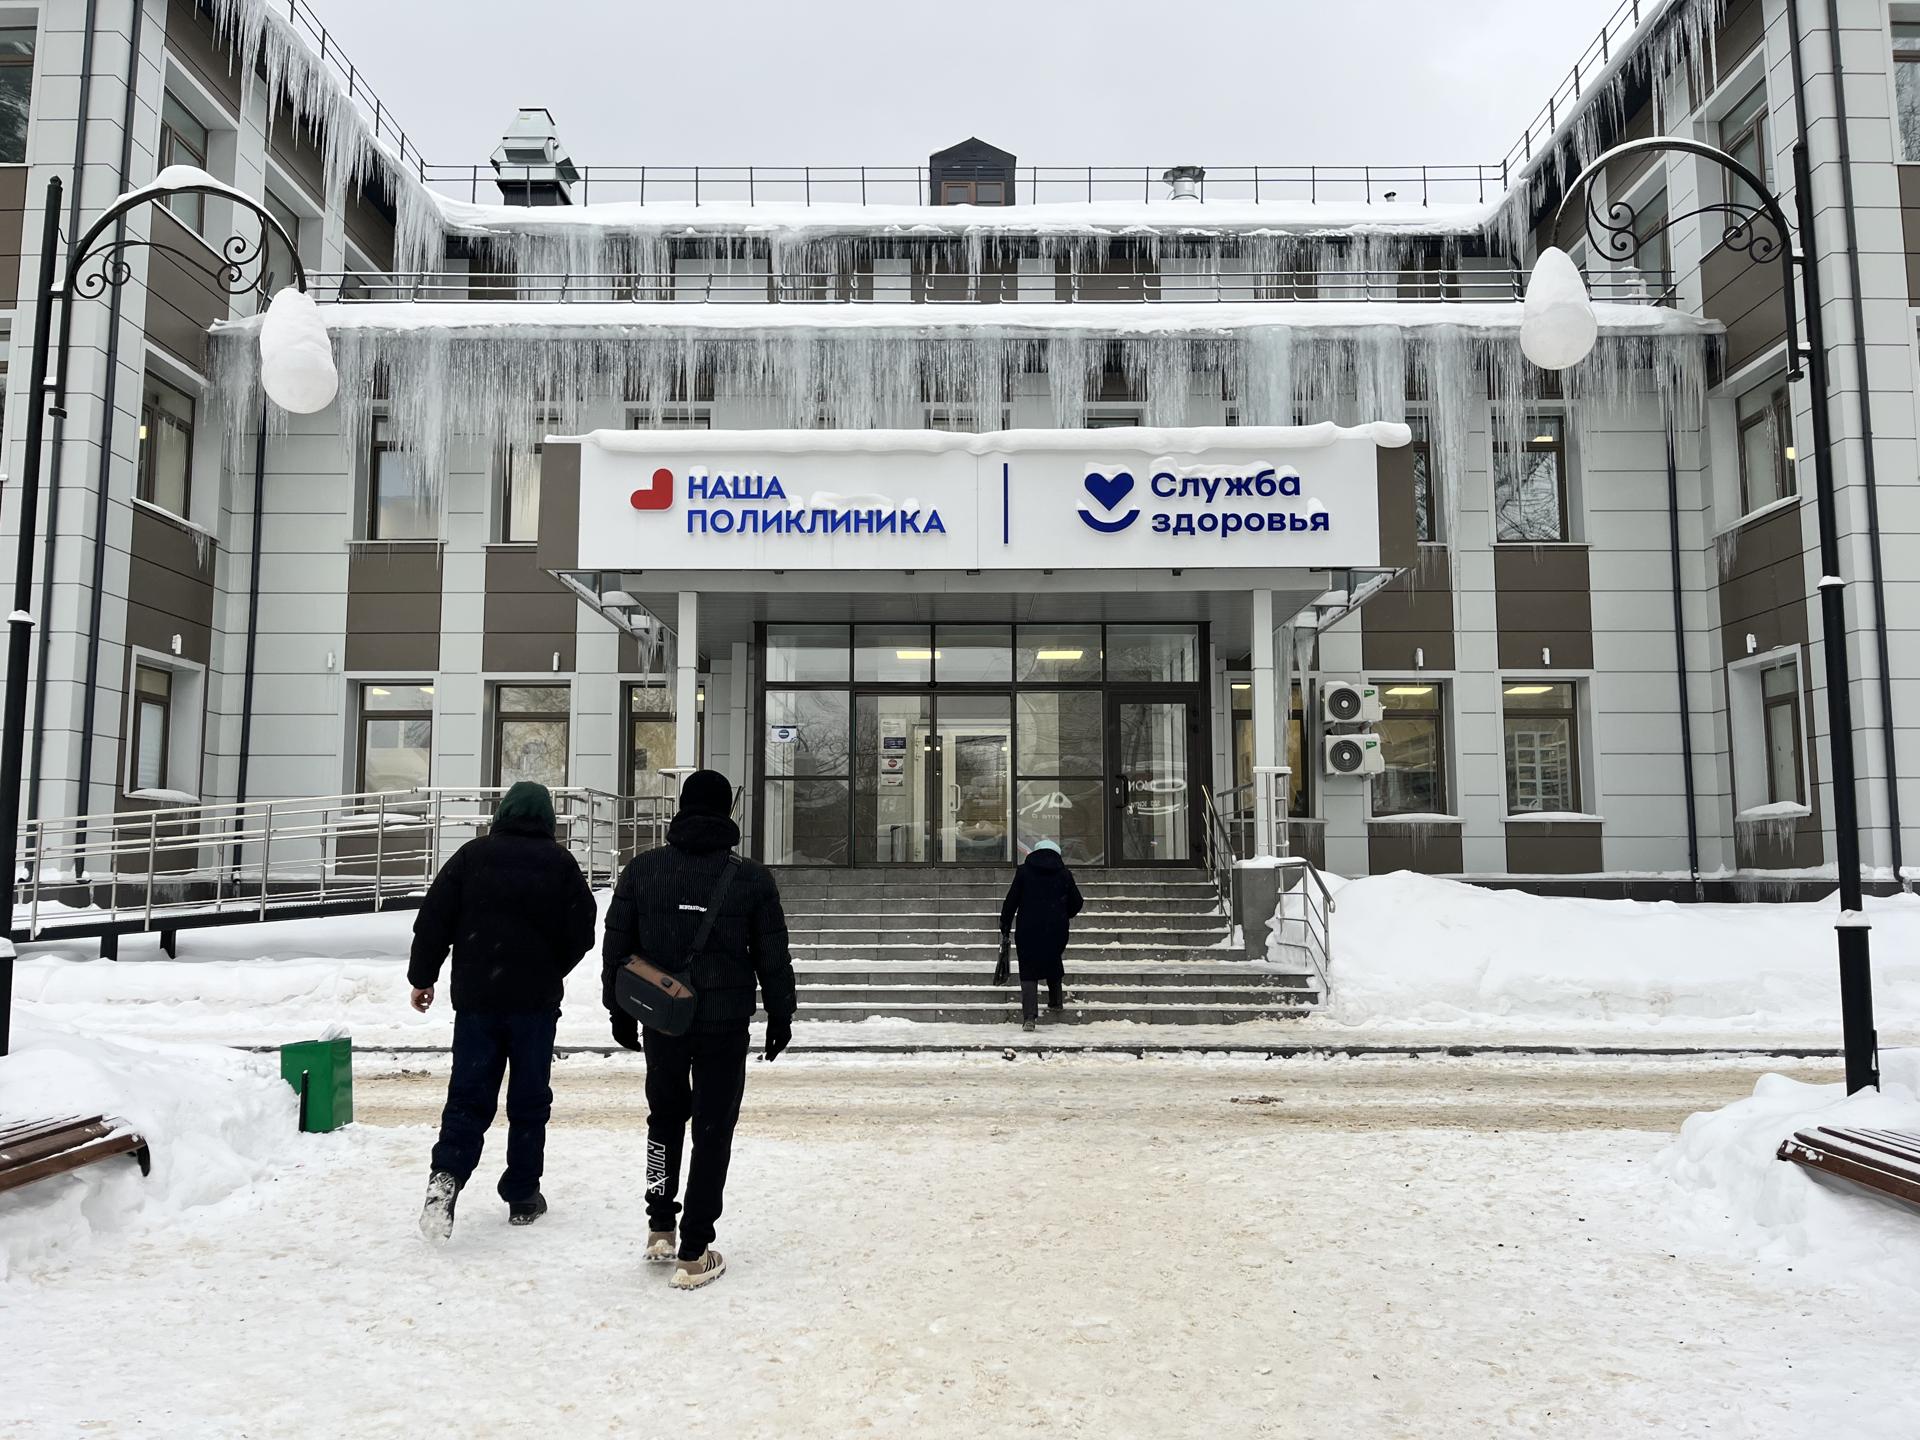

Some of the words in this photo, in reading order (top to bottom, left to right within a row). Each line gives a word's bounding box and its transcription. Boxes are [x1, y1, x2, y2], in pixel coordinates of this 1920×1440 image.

[688, 475, 787, 499] НАША
[1151, 469, 1300, 504] Служба
[687, 509, 946, 534] ПОЛИКЛИНИКА
[1151, 512, 1330, 538] здоровья
[647, 1139, 667, 1196] NIKE
